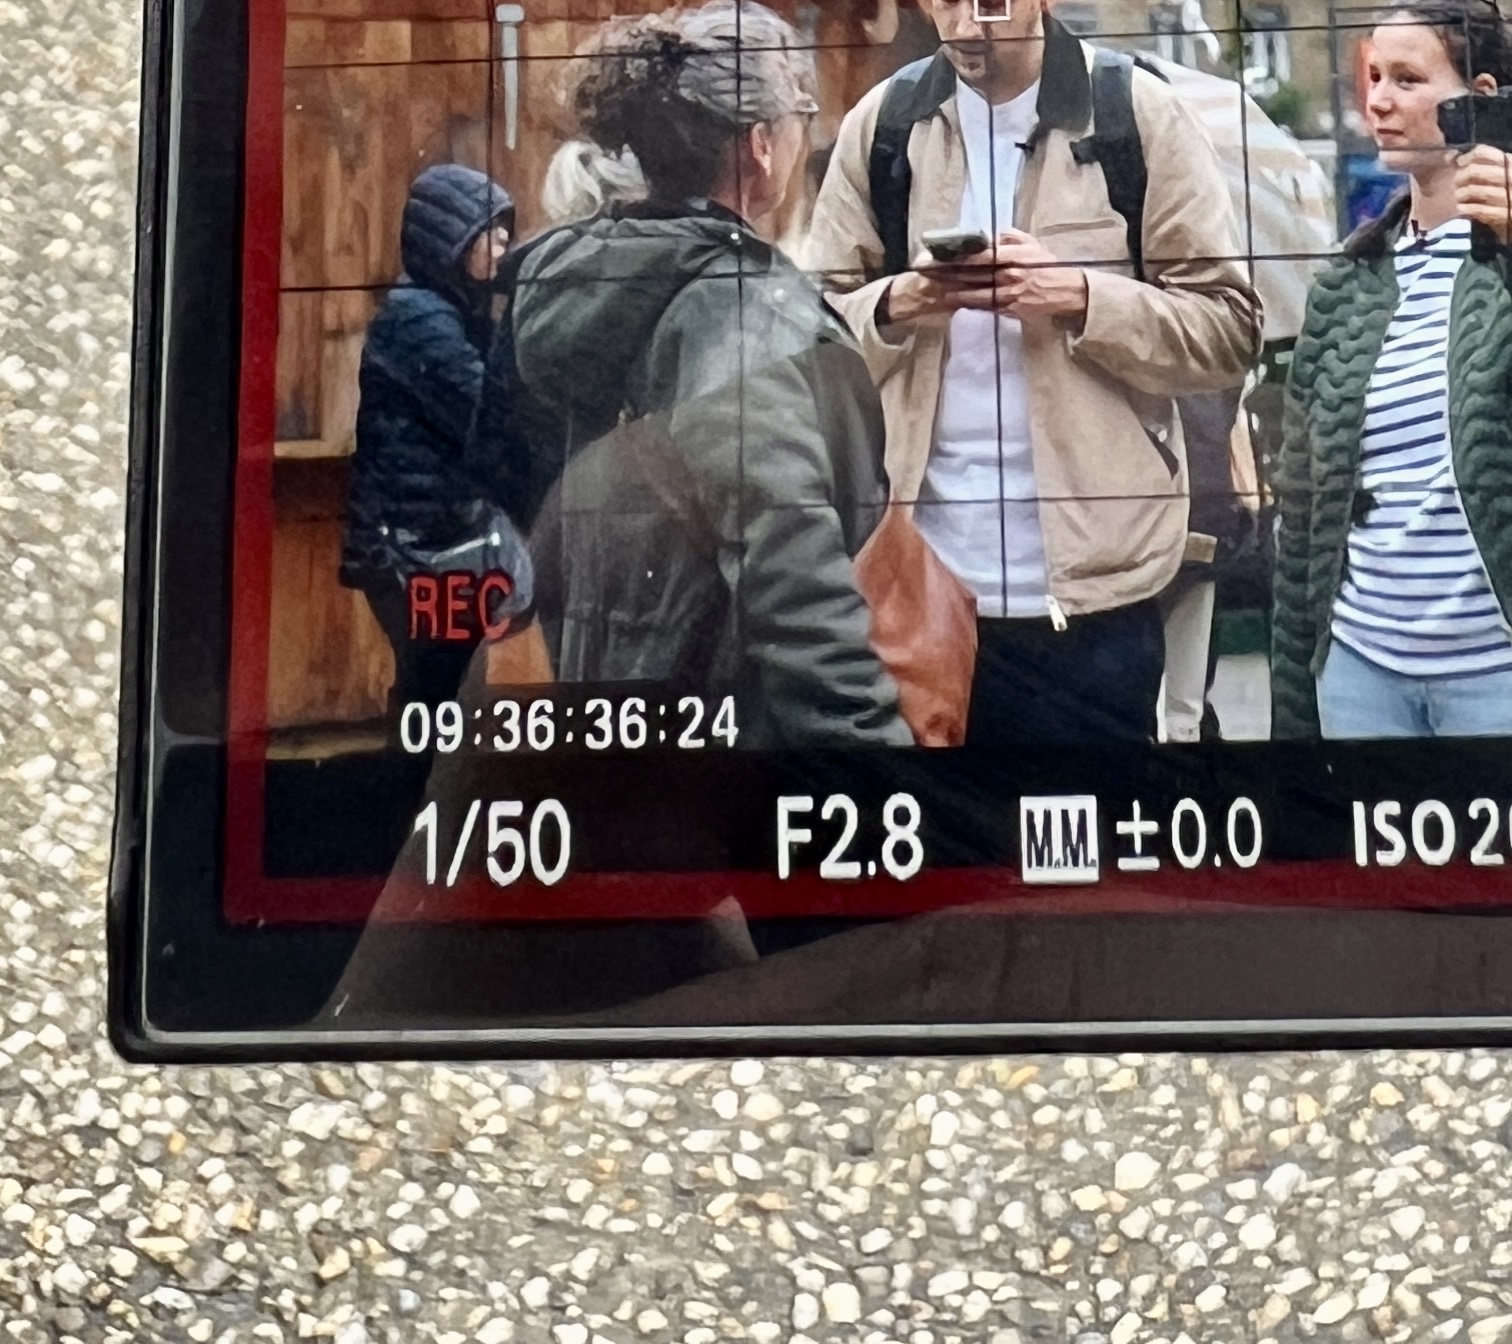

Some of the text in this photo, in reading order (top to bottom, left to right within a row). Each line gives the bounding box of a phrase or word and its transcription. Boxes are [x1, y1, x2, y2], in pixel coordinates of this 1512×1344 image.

[410, 574, 512, 640] REC
[400, 695, 740, 754] 09:36:36:24
[413, 797, 571, 887] 1/50
[776, 792, 925, 881] F2.8
